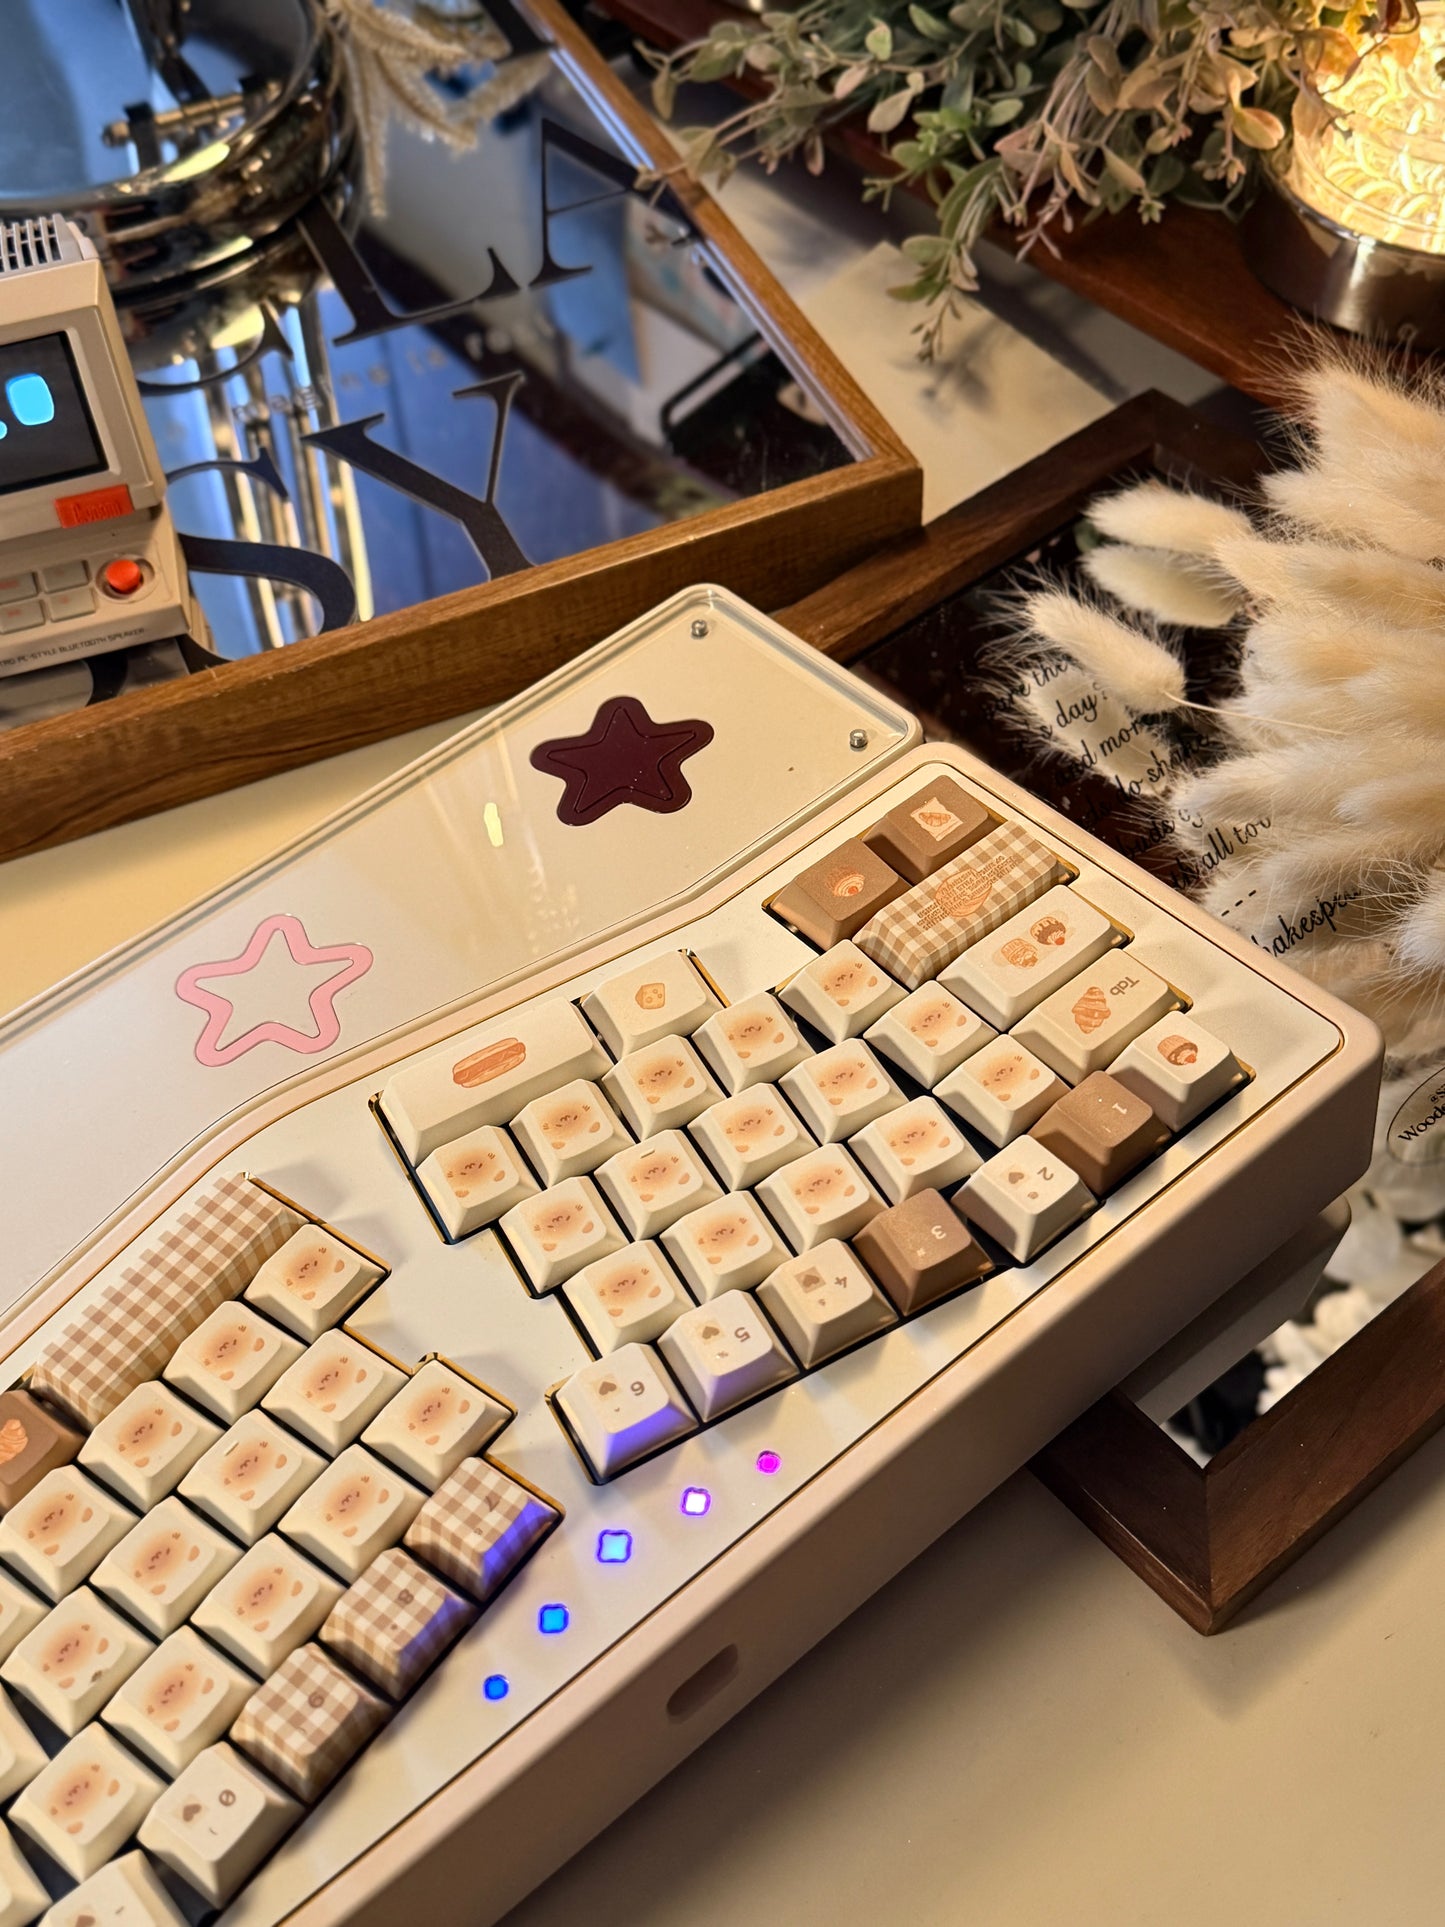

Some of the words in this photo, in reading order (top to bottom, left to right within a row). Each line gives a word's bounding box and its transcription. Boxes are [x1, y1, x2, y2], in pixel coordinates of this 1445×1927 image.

[108, 628, 145, 643] SPEAKER
[1202, 827, 1236, 871] all
[1109, 976, 1140, 996] Tab
[1111, 1101, 1128, 1116] 1
[1036, 1166, 1055, 1181] 2
[930, 1224, 947, 1240] 3
[834, 1276, 848, 1289] 4
[734, 1326, 751, 1343] 5
[629, 1380, 646, 1397] 6
[397, 1588, 415, 1605] 8
[218, 1789, 237, 1807] 0
